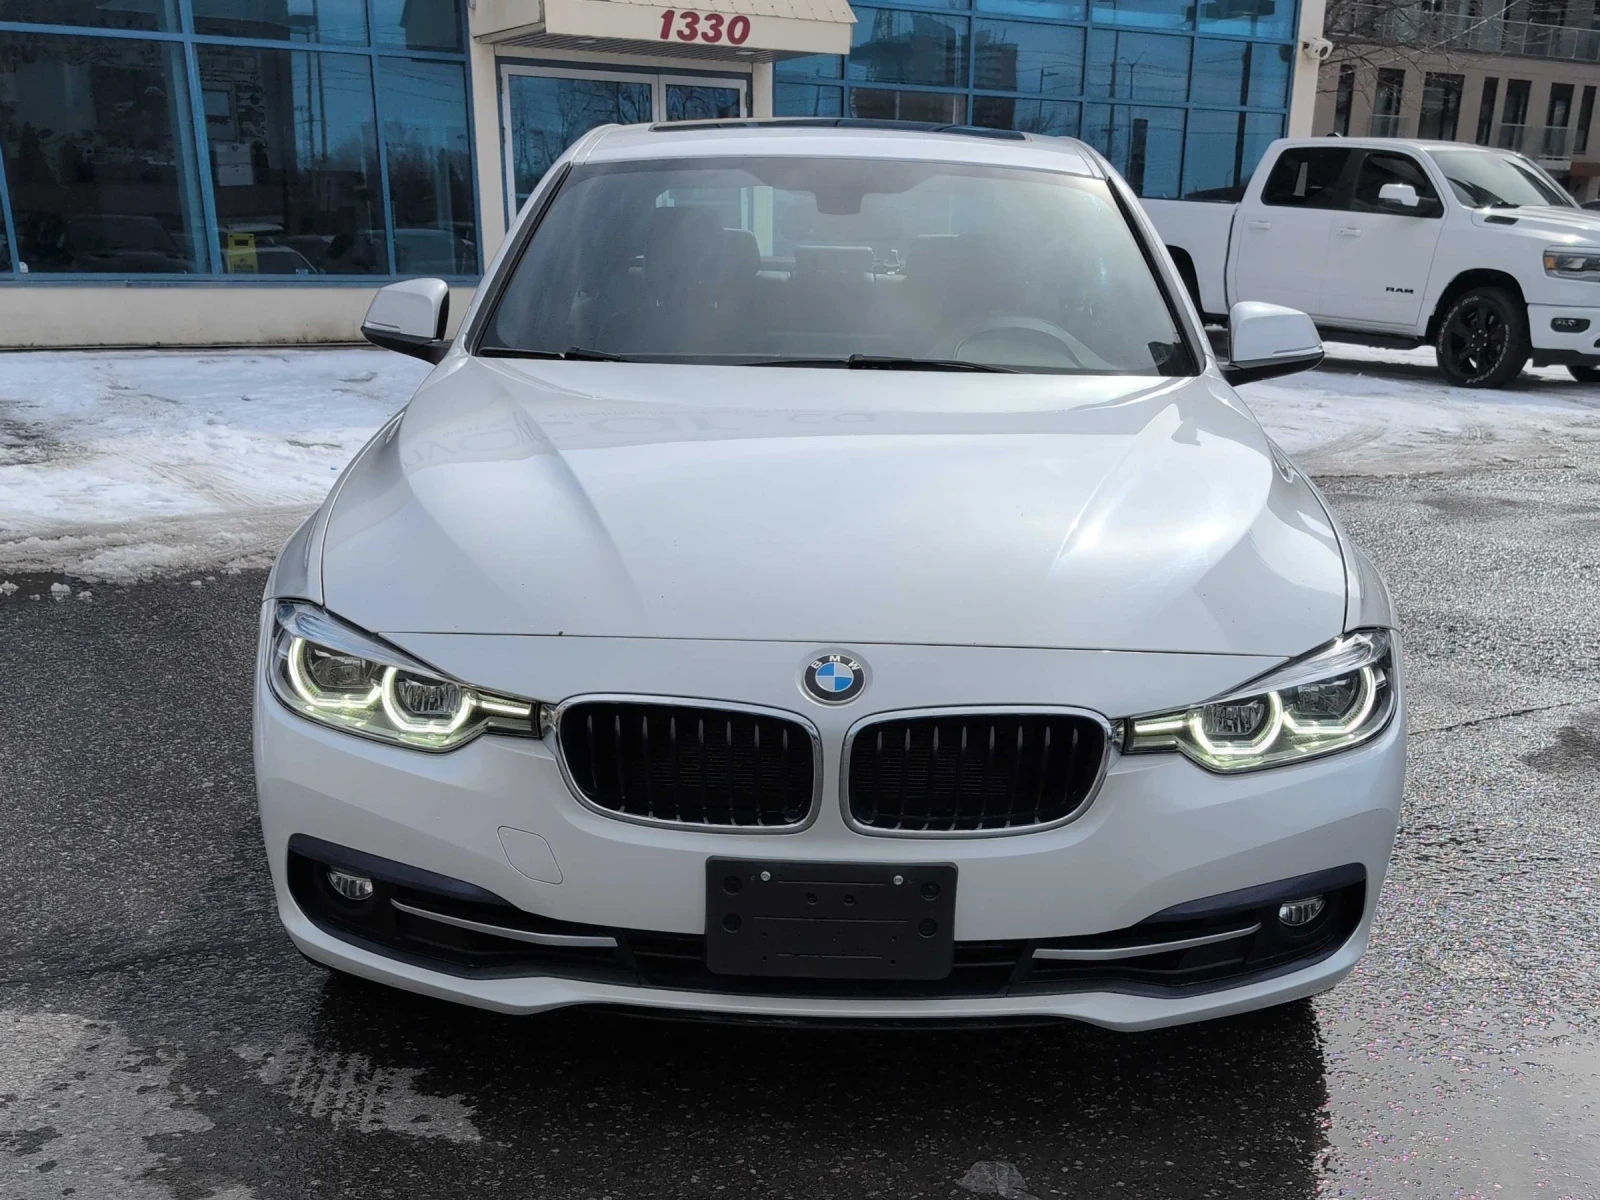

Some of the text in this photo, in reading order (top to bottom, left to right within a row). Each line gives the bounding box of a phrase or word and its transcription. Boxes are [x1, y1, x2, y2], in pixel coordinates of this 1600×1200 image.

[660, 9, 751, 45] 1330
[1385, 286, 1414, 294] RAM
[810, 655, 861, 671] BMW
